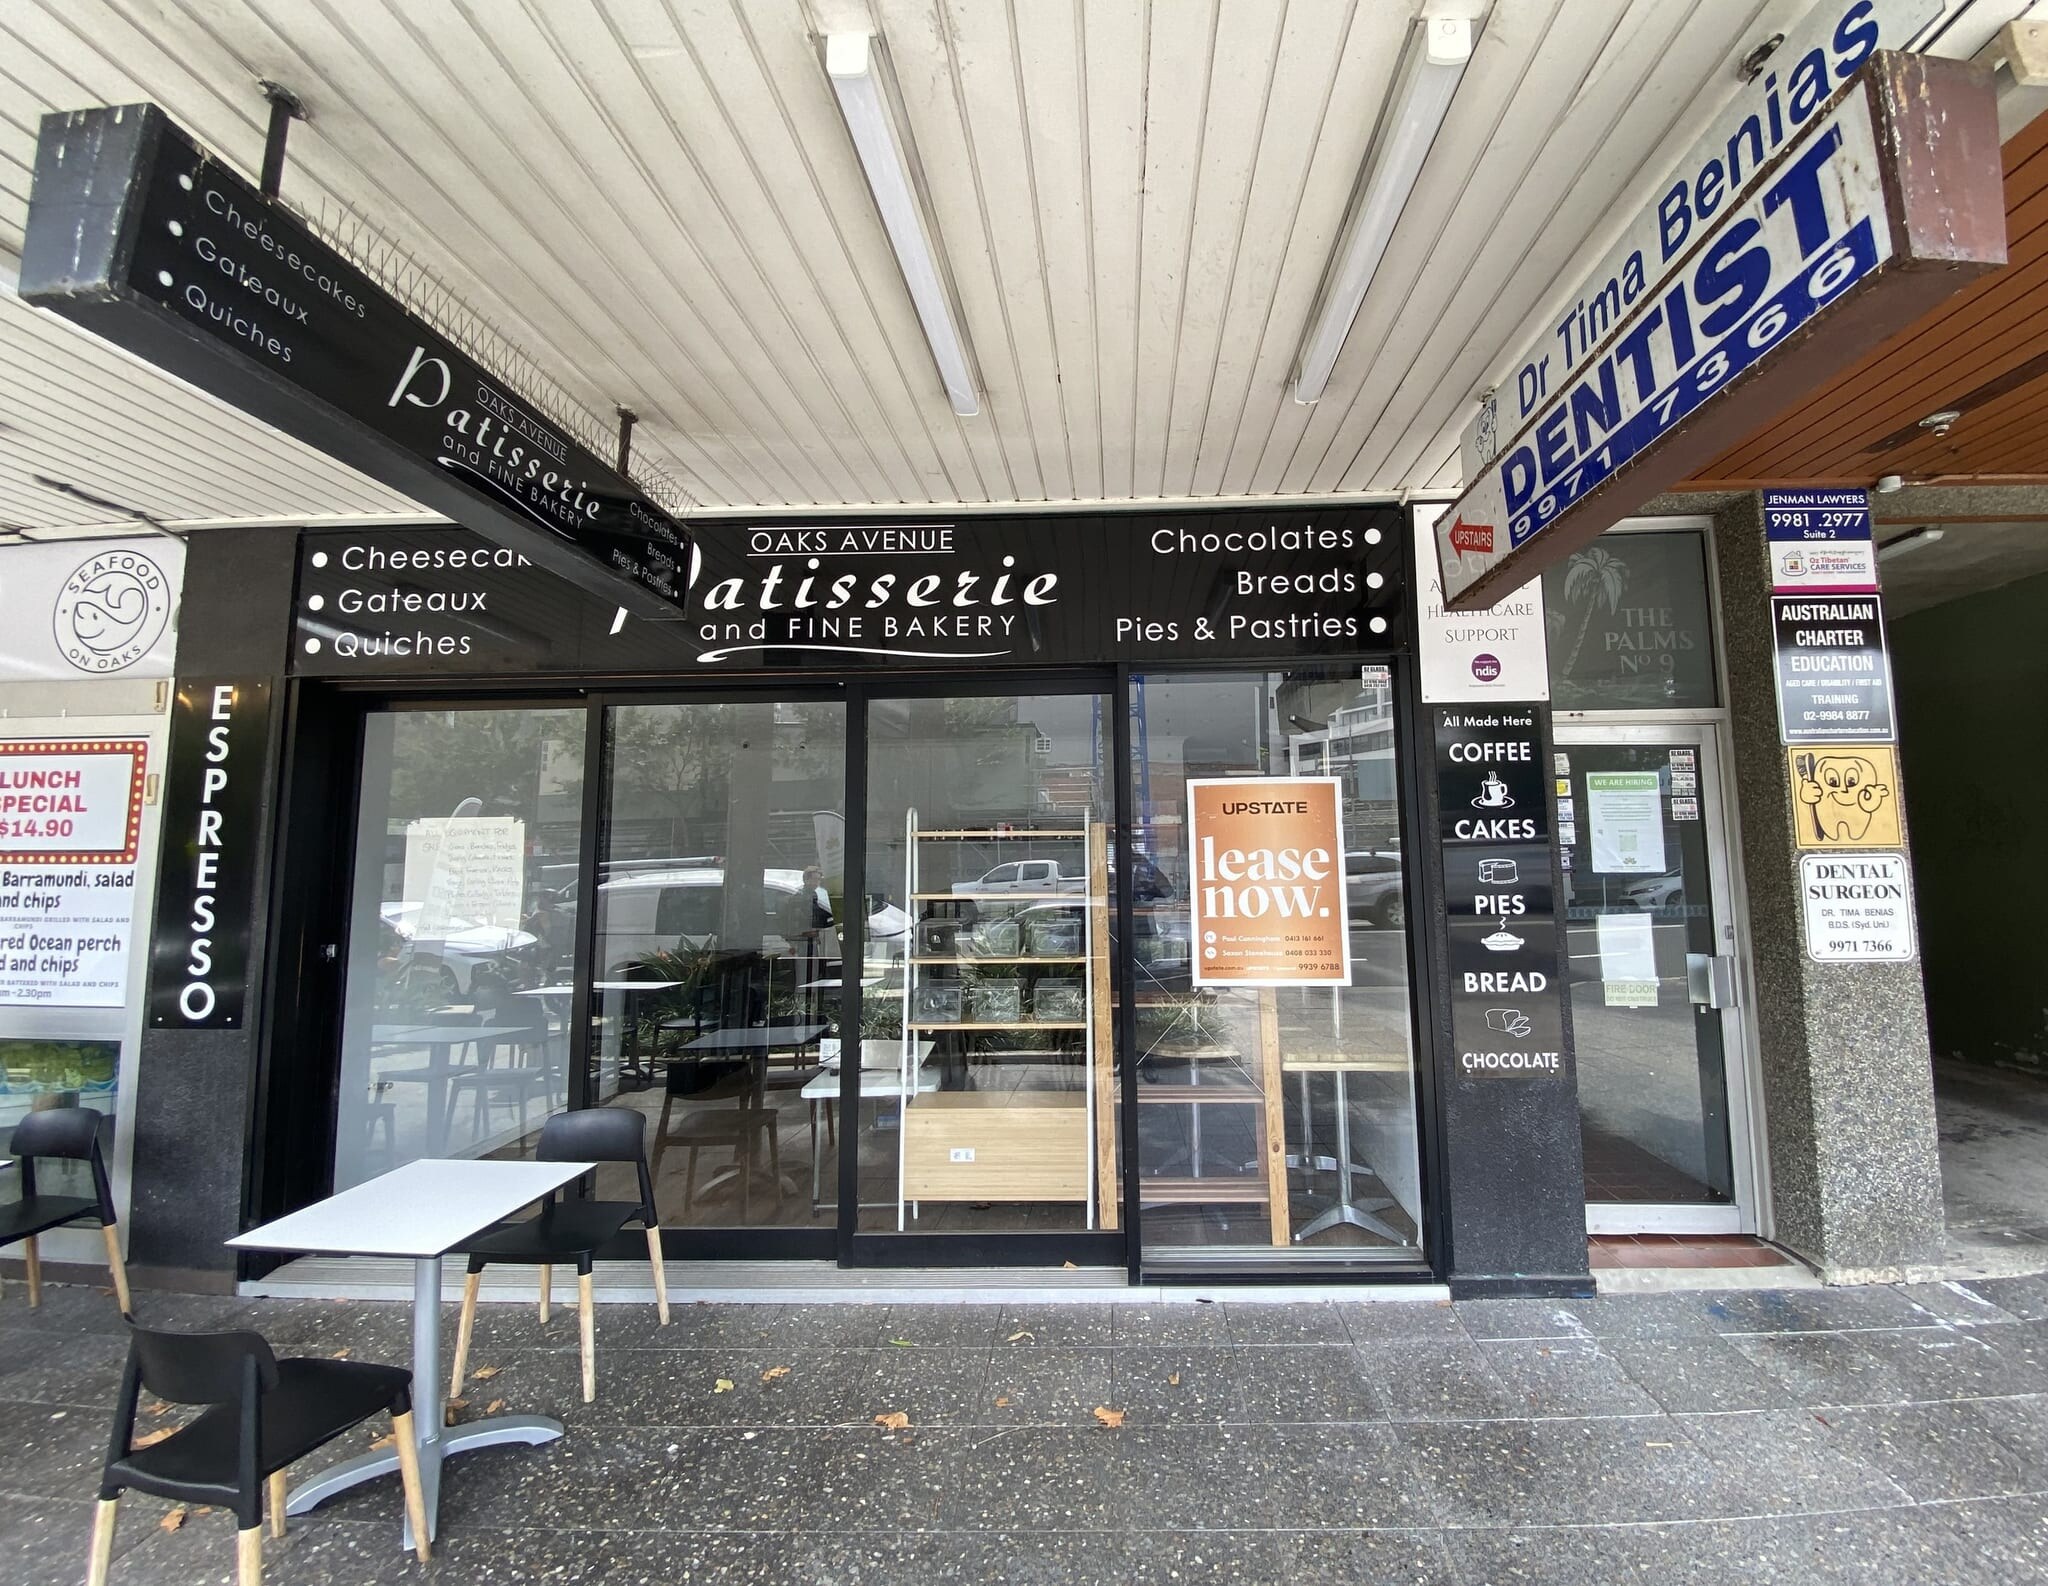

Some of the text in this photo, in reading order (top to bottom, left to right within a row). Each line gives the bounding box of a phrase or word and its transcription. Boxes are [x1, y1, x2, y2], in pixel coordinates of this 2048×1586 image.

[1518, 0, 1879, 420] Dr Tima Benias
[205, 190, 365, 318] Cheesecakes
[196, 237, 309, 326] Gateaux
[185, 284, 292, 363] Quiches
[1501, 121, 1843, 519] DENTIST
[1513, 246, 1856, 539] 9971 7366
[388, 346, 600, 520] Patisserie
[477, 386, 568, 461] OAKS AVENUE
[443, 435, 584, 530] and FINE BAKERY
[1768, 495, 1865, 504] JENMAN LAWYERS
[629, 502, 680, 545] Chocolates
[1771, 513, 1809, 527] 9981
[751, 530, 954, 553] OAKS AVENUE
[1151, 526, 1354, 554] Chocolates
[1454, 530, 1493, 547] UPSTAIRS
[1803, 530, 1836, 539] Suite 2
[647, 542, 675, 571] Breads
[68, 556, 160, 594] SEAFOOD
[612, 548, 672, 597] Pies & Pastries
[1237, 568, 1355, 595] Breads
[338, 589, 487, 613] Gateaux
[1621, 608, 1673, 626] THE
[1781, 604, 1873, 620] AUSTRALIAN
[700, 615, 1016, 641] and FINE BAKERY
[1116, 613, 1357, 642] Pies & Pastries
[1445, 628, 1519, 643] SUPPORT
[334, 631, 471, 658] Quiches
[1604, 632, 1696, 650] PALMS
[1796, 630, 1864, 646] CHARTER
[69, 645, 141, 669] ON OAKS
[1659, 654, 1675, 674] 9
[1791, 656, 1874, 671] EDUCATION
[1475, 666, 1497, 676] ndis
[1811, 694, 1859, 704] TRAINING
[1443, 715, 1532, 727] All Made Here
[1803, 710, 1870, 720] 02-9984 8877
[1449, 742, 1531, 762] COFFEE
[0, 770, 81, 788] LUNCH
[0, 795, 87, 813] PECIAL
[1223, 801, 1308, 815] UPSTATE
[0, 818, 73, 838] $14.90
[1454, 819, 1536, 840] CAKES
[179, 685, 234, 1021] ESPRESSO
[1201, 836, 1330, 881] lease
[2, 870, 134, 889] Barramundi, salad
[1816, 864, 1893, 879] DENTAL
[1202, 885, 1330, 918] now.
[1809, 884, 1902, 900] SURGEON
[0, 891, 61, 914] nd chips
[1474, 895, 1525, 915] PIES
[1821, 908, 1894, 917] DR. TIMA BENIAS
[1828, 921, 1850, 929] B.D.S.
[29, 934, 72, 951] Ocean
[77, 934, 121, 956] perch
[1829, 939, 1893, 953] 9971 7366
[10, 954, 37, 971] and
[41, 955, 79, 977] chips
[1463, 972, 1547, 993] BREAD
[1629, 984, 1656, 993] DOOR
[1462, 1053, 1560, 1069] CHOCOLATE
